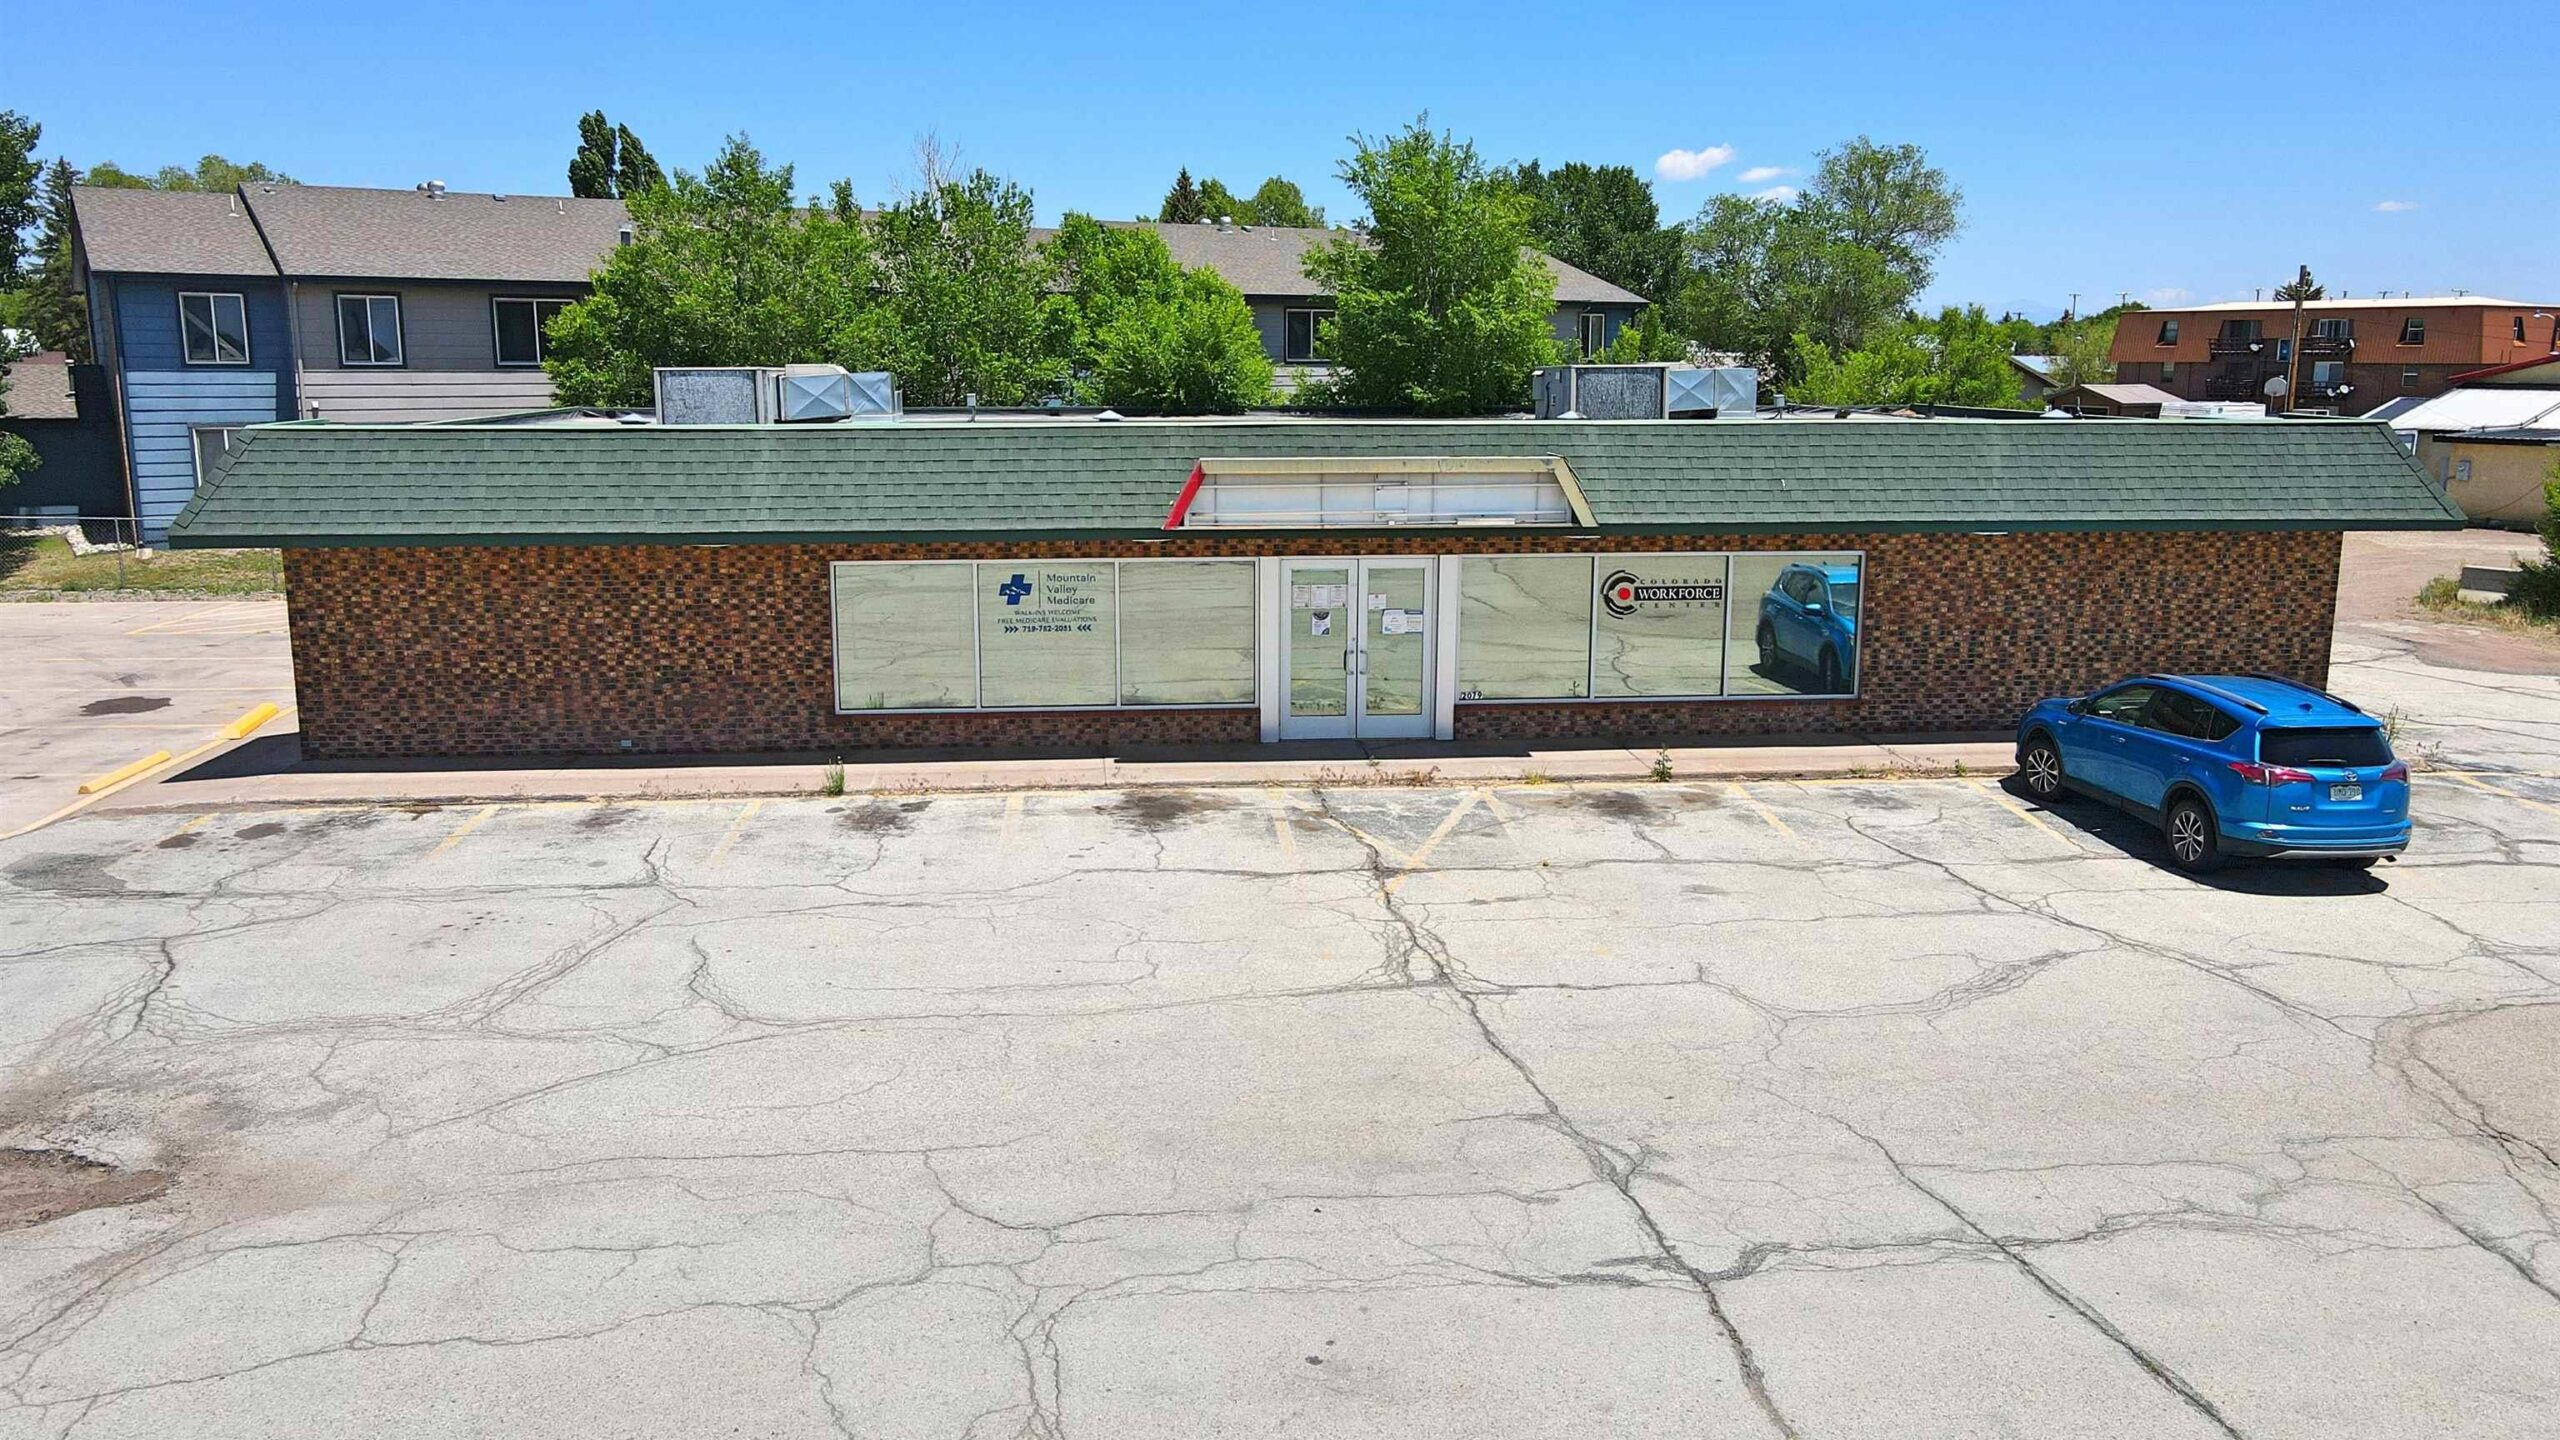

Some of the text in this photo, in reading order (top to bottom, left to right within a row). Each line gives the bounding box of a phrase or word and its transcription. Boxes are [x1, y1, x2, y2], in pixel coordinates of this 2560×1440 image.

[1046, 573, 1096, 582] Mountain
[1046, 585, 1078, 596] Valley
[1638, 587, 1720, 600] WORKFORCE
[1047, 596, 1096, 605] Medicare
[1460, 691, 1483, 700] 2079
